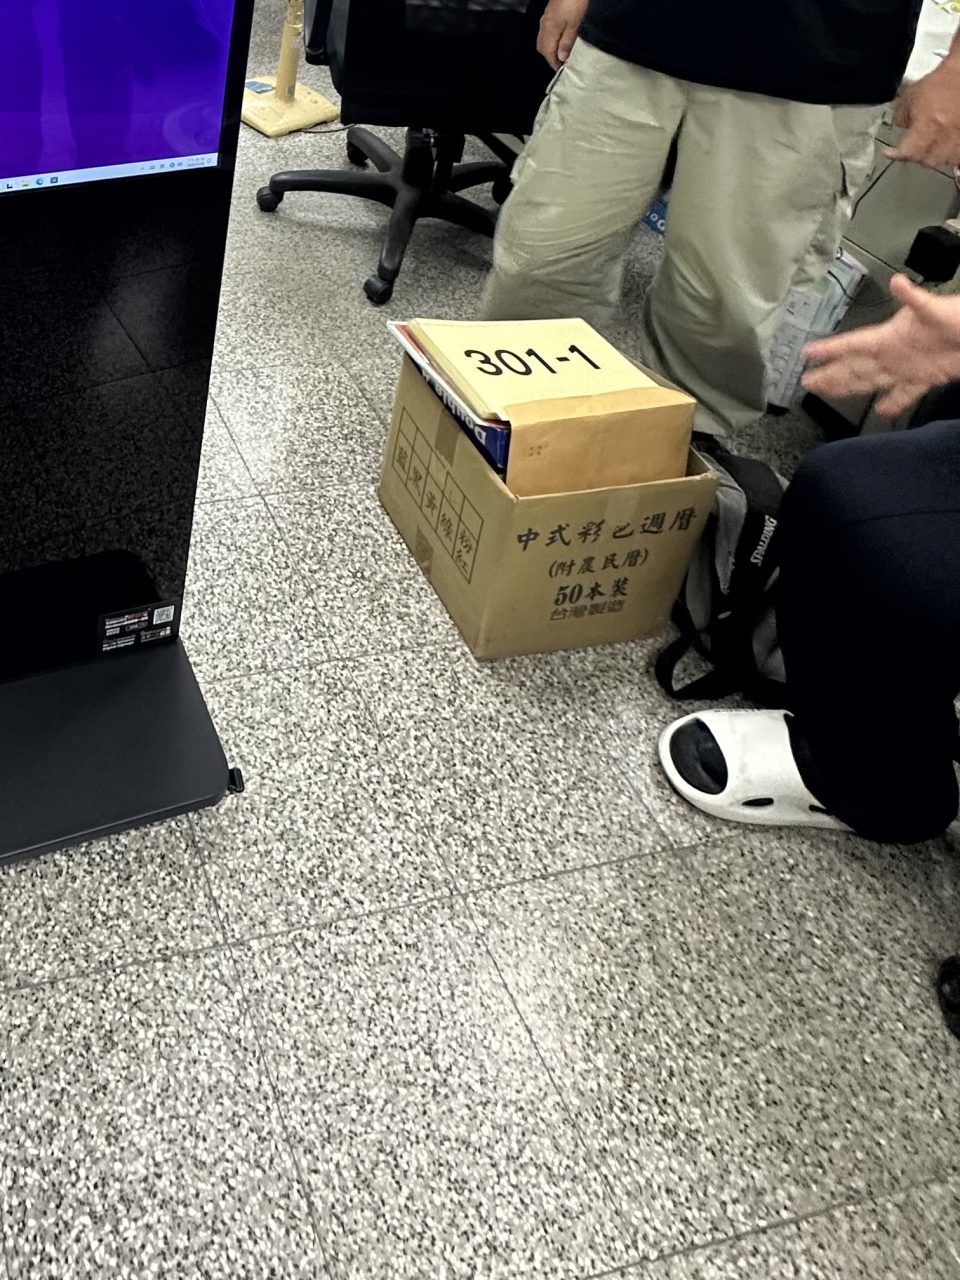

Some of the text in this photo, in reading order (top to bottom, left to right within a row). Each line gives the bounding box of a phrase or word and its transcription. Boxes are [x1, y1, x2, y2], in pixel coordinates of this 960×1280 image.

[464, 344, 601, 376] 301-1
[750, 514, 778, 568] SPALDING
[554, 577, 630, 607] 50本裝
[550, 599, 625, 621] 台灣製造
